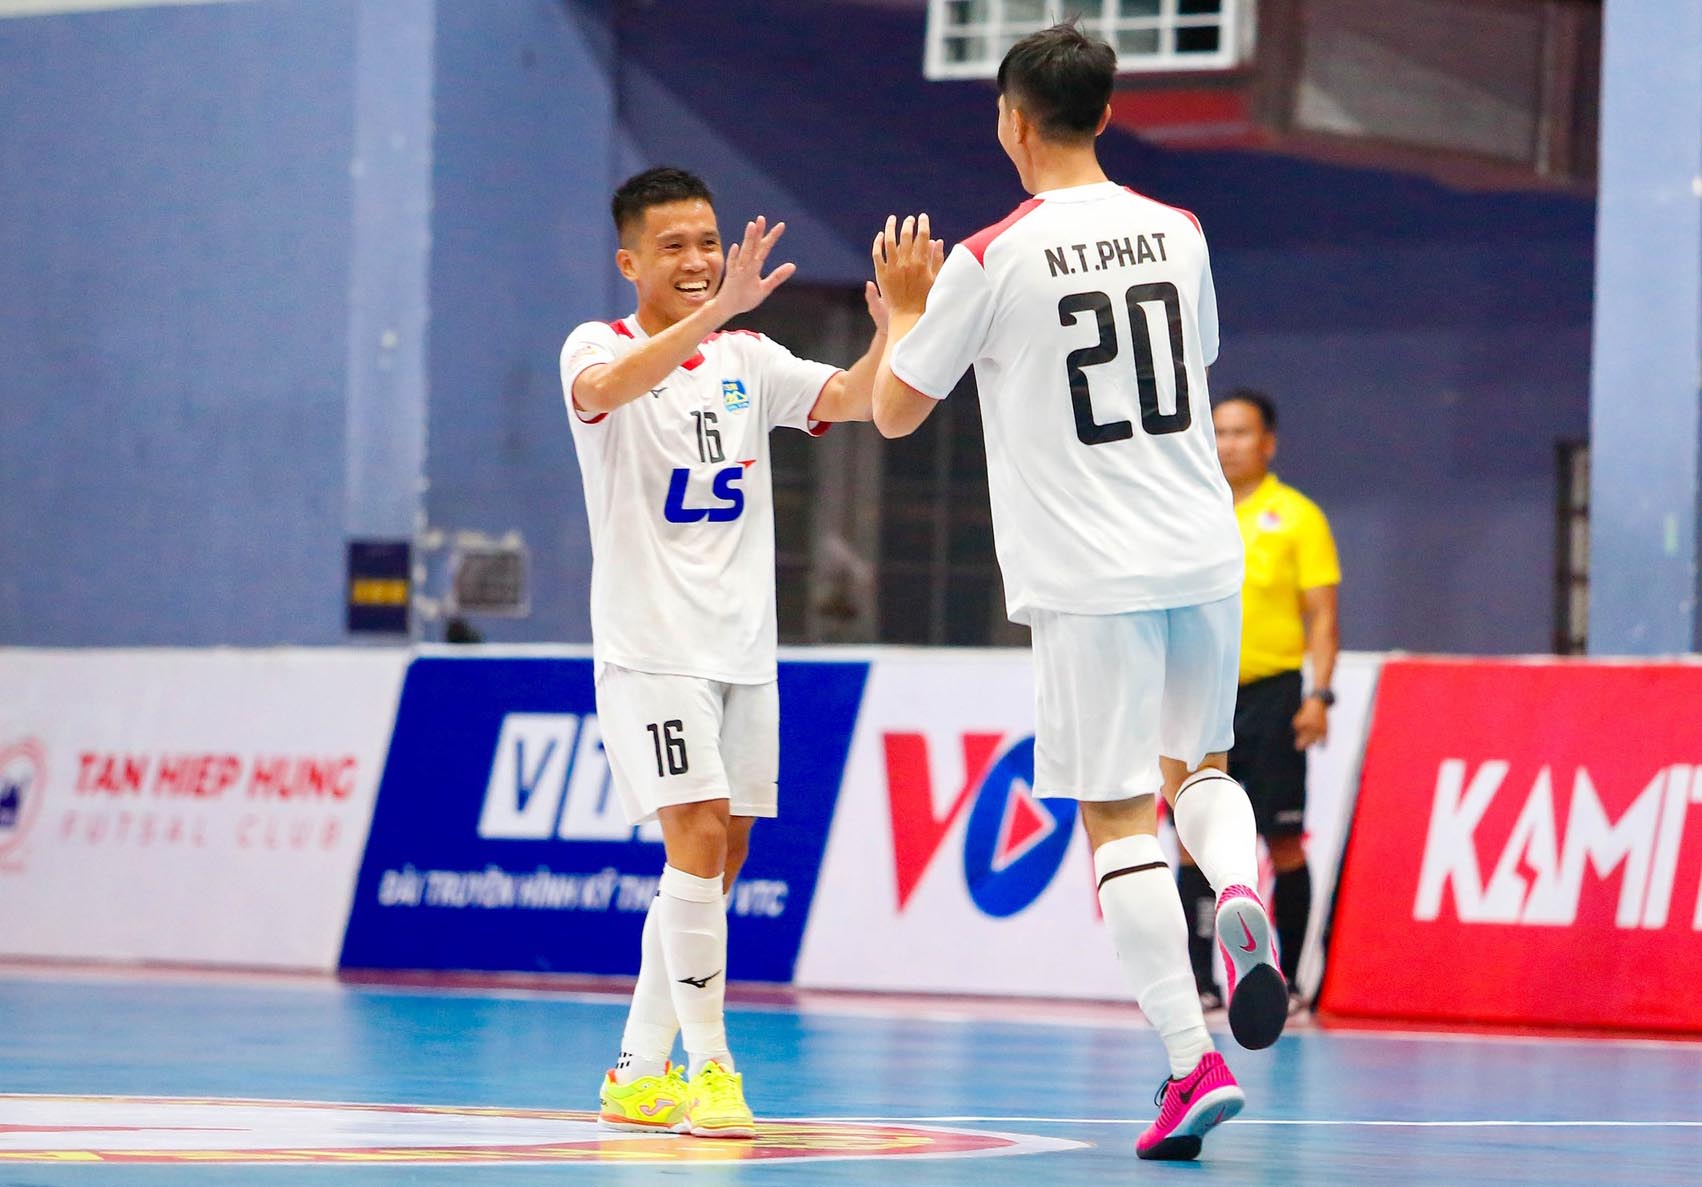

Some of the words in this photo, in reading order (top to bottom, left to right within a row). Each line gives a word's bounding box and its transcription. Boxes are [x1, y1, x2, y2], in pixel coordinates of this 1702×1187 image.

[1044, 232, 1169, 278] N.T.PHAT
[1058, 281, 1192, 446] 20
[689, 410, 726, 464] 16
[663, 466, 745, 524] LS
[646, 719, 689, 778] 16
[74, 753, 147, 796] TAN
[153, 753, 243, 800] HIEP
[246, 755, 358, 803] HUNG
[1413, 758, 1702, 931] KAMI
